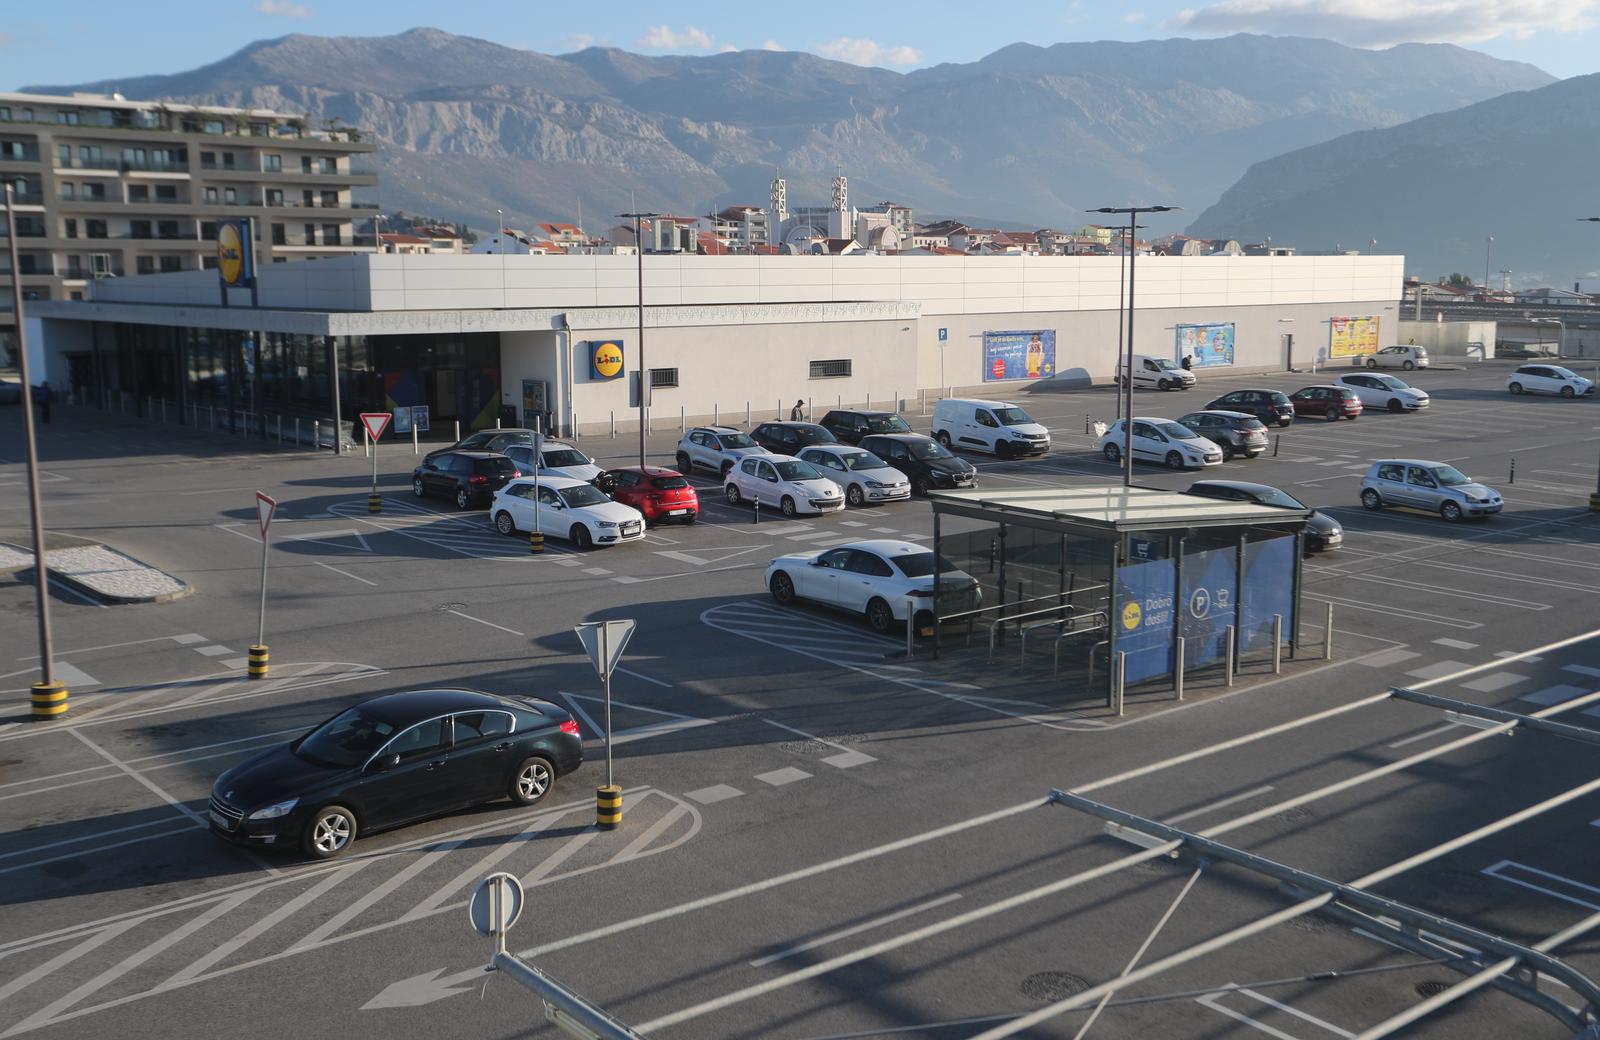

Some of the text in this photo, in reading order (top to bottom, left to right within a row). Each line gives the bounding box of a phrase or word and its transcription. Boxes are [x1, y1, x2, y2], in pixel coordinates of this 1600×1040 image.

[940, 330, 945, 339] P
[597, 354, 621, 364] LIDL
[1196, 597, 1204, 610] P
